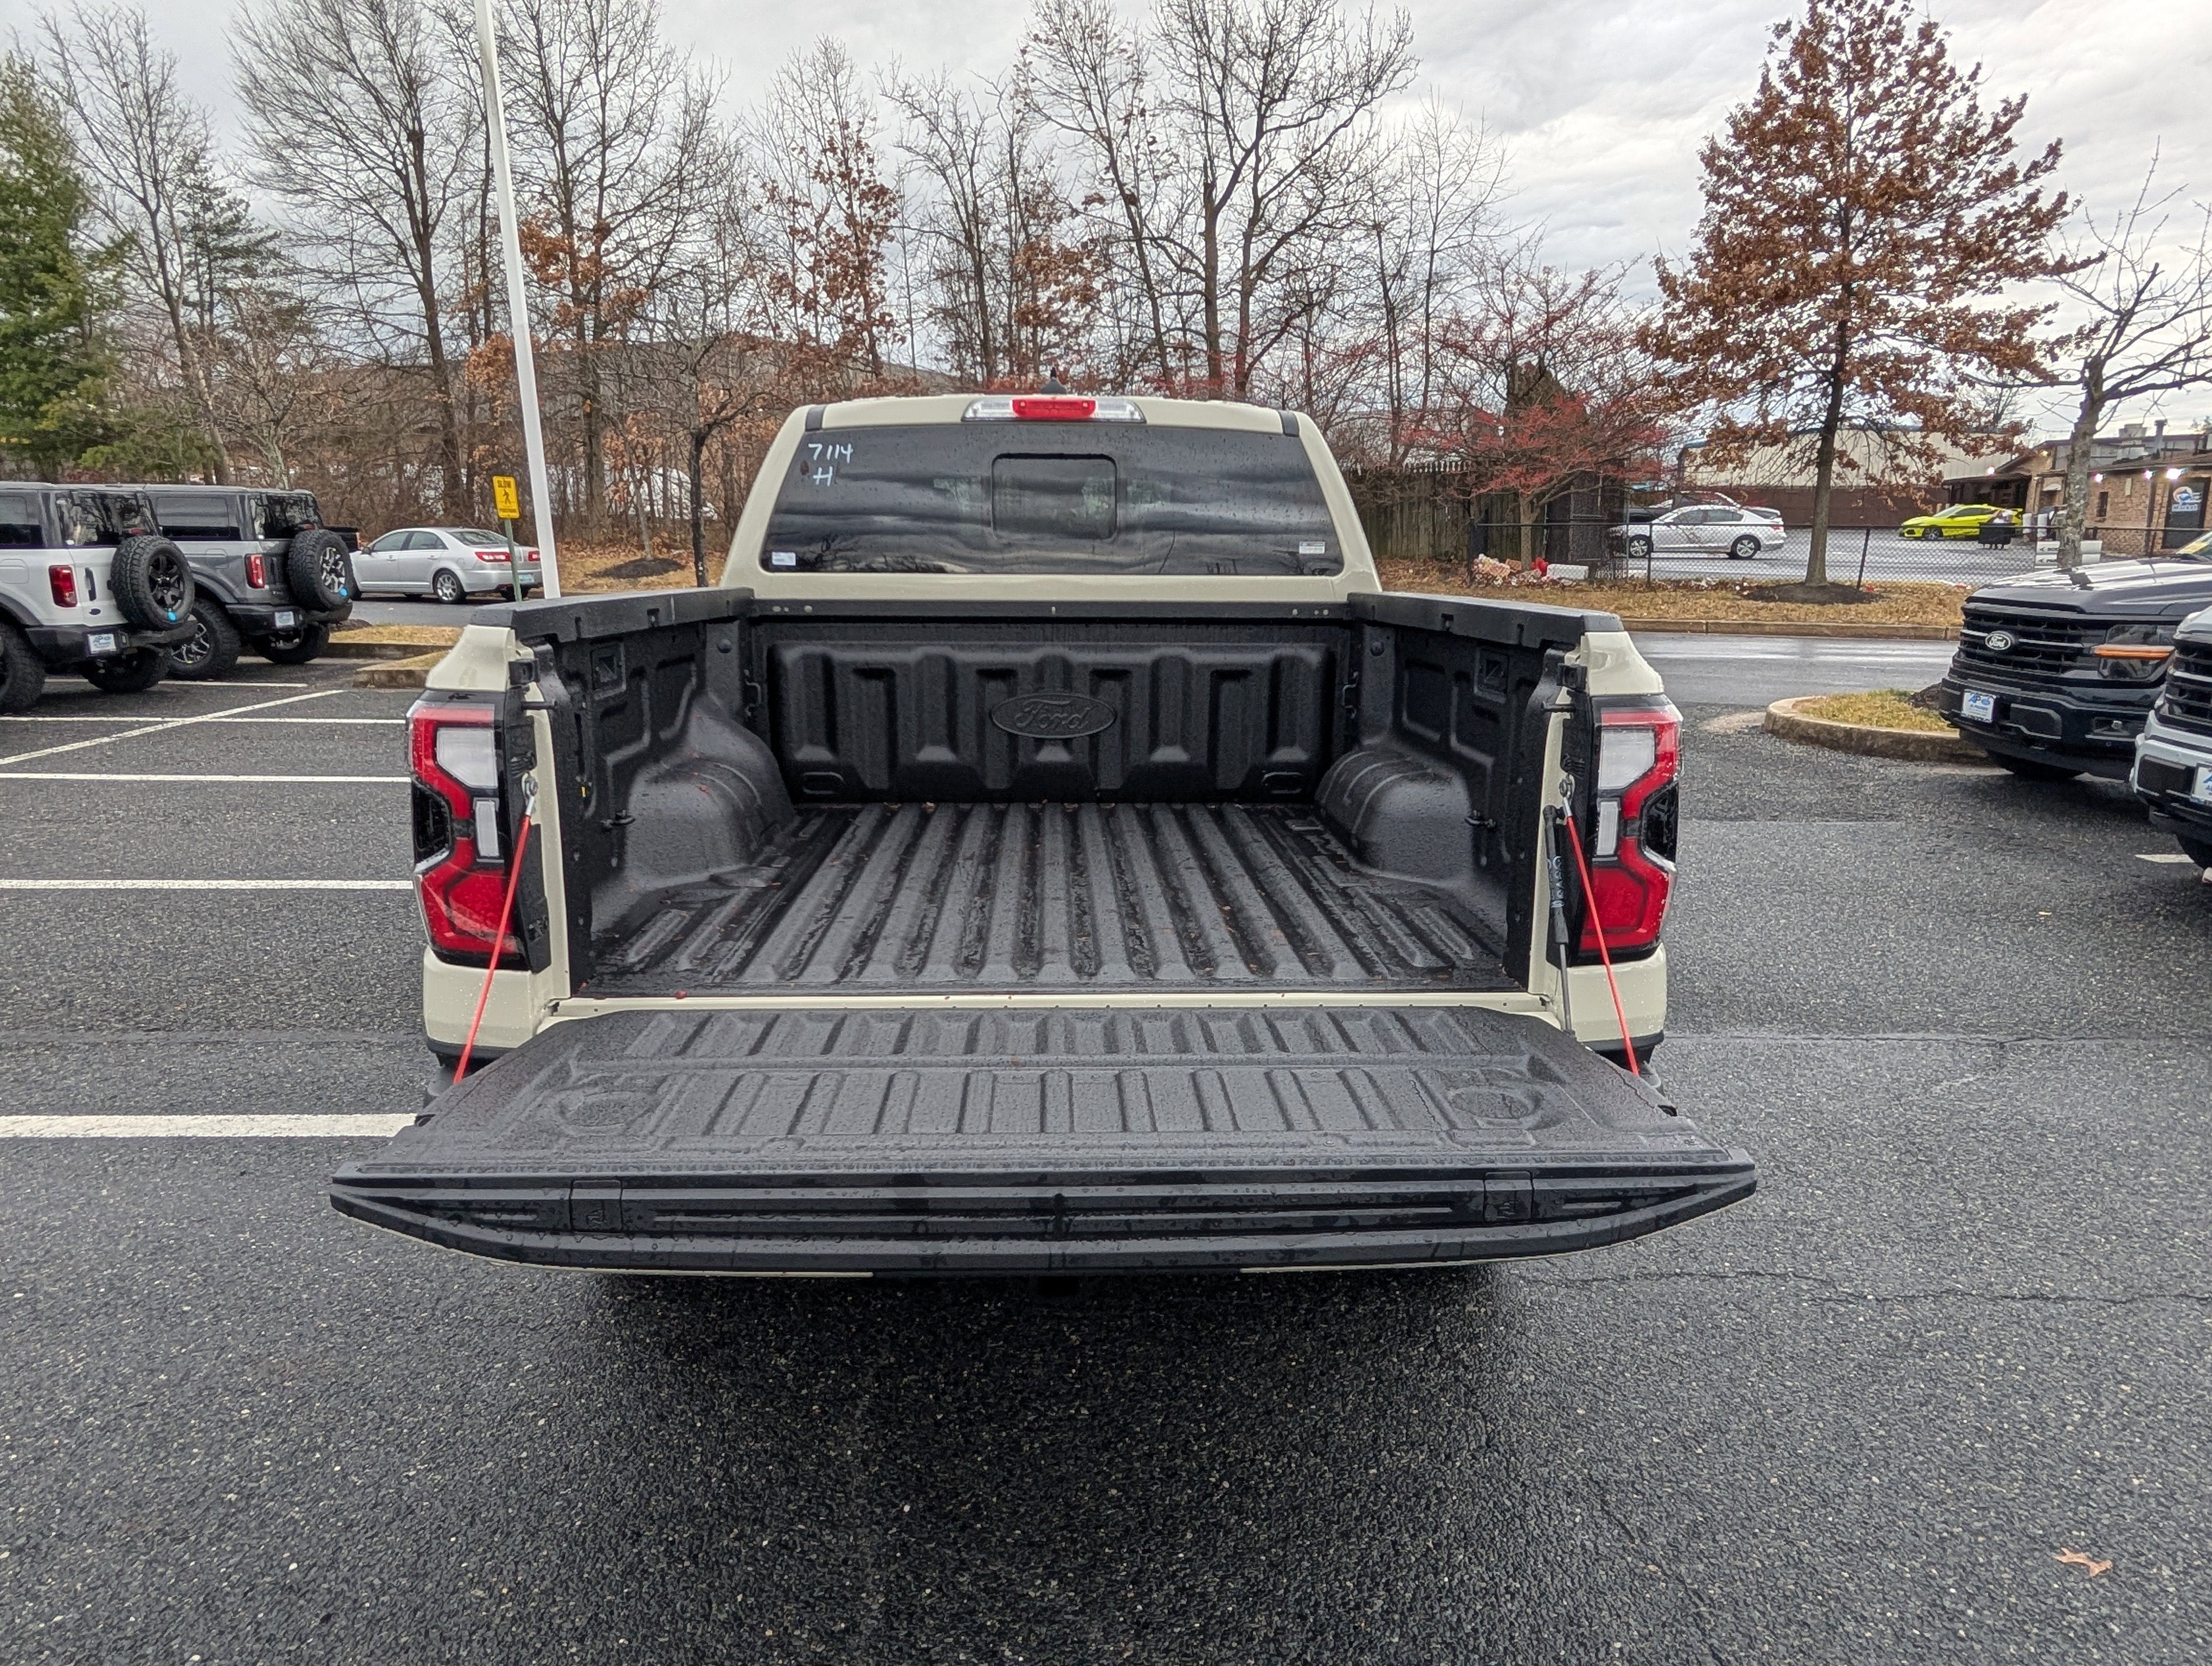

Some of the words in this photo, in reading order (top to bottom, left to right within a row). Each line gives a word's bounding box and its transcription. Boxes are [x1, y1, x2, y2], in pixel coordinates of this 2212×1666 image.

[808, 443, 853, 463] 7114
[813, 466, 833, 486] H
[1989, 636, 2006, 648] Ford
[1015, 699, 1091, 729] Ford
